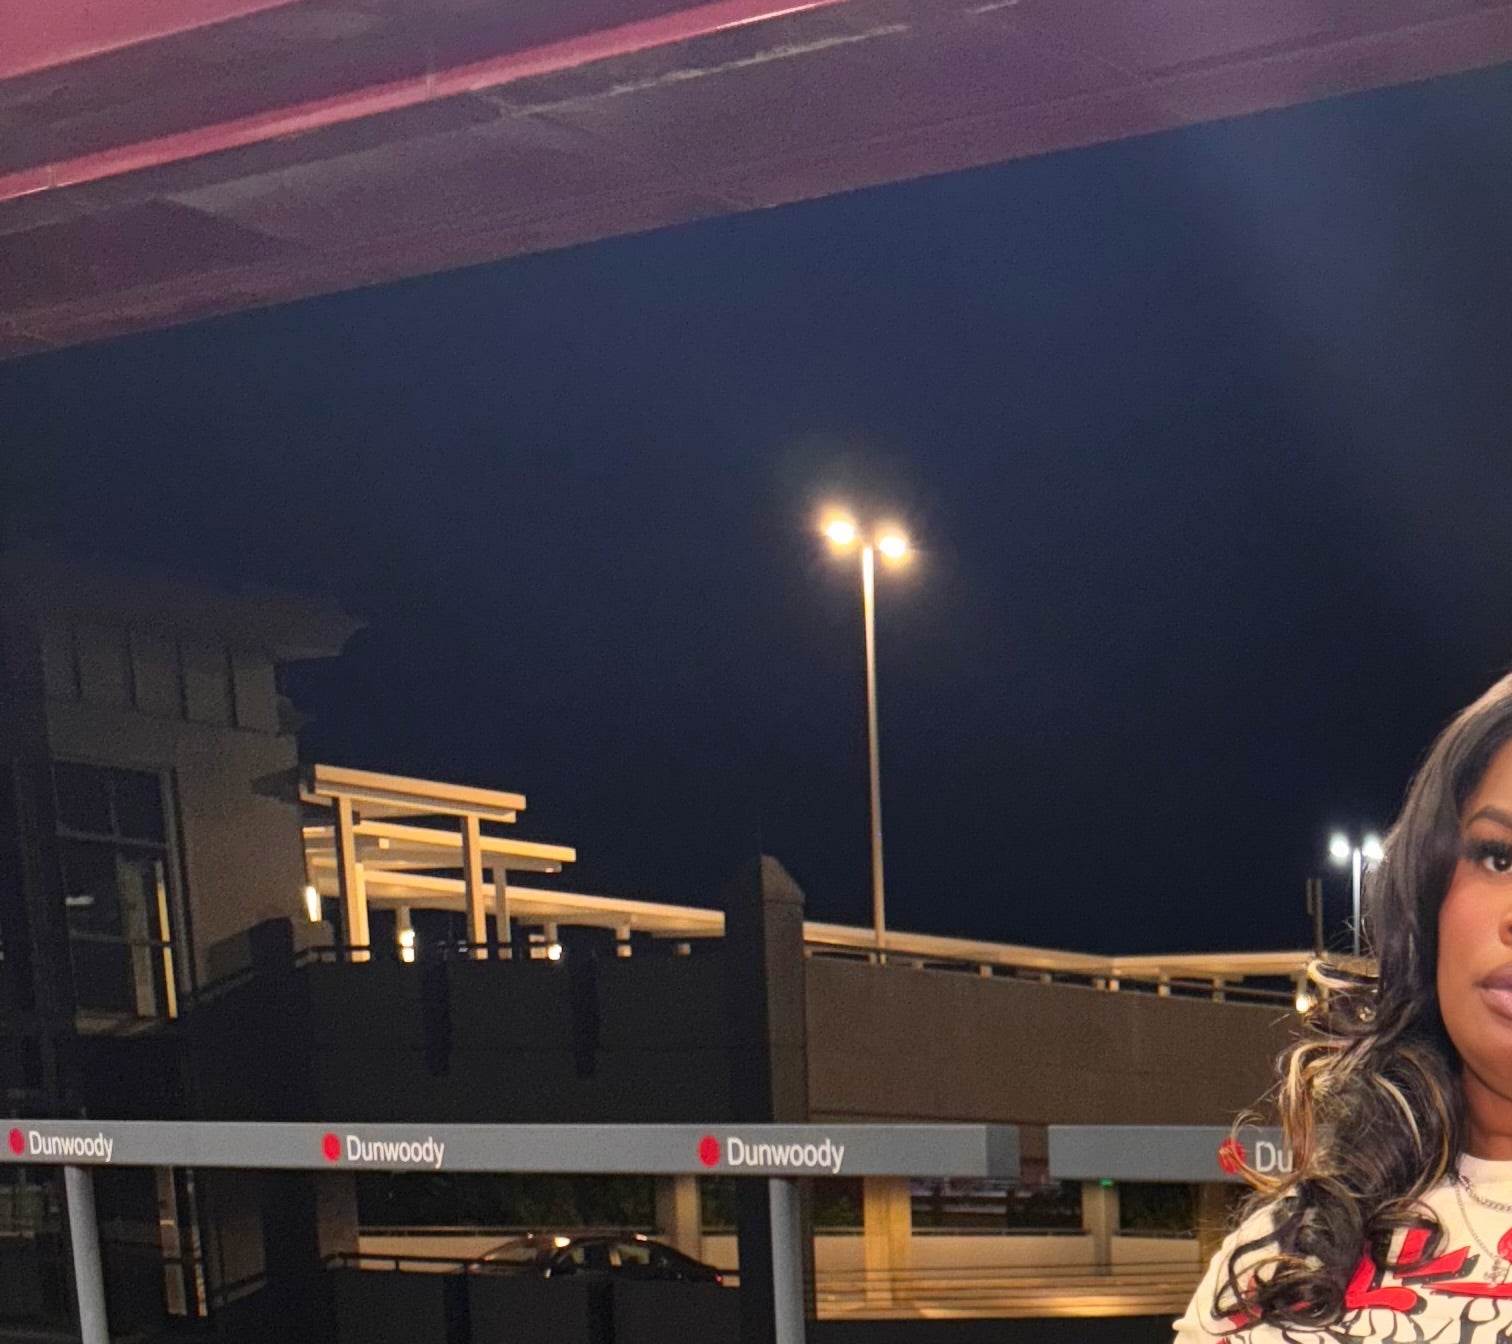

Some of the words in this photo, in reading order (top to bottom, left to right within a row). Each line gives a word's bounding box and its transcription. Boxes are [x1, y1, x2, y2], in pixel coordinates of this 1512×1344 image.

[28, 1130, 113, 1163] Dunwoody
[346, 1134, 445, 1169] Dunwoody
[727, 1136, 845, 1174] Dunwoody
